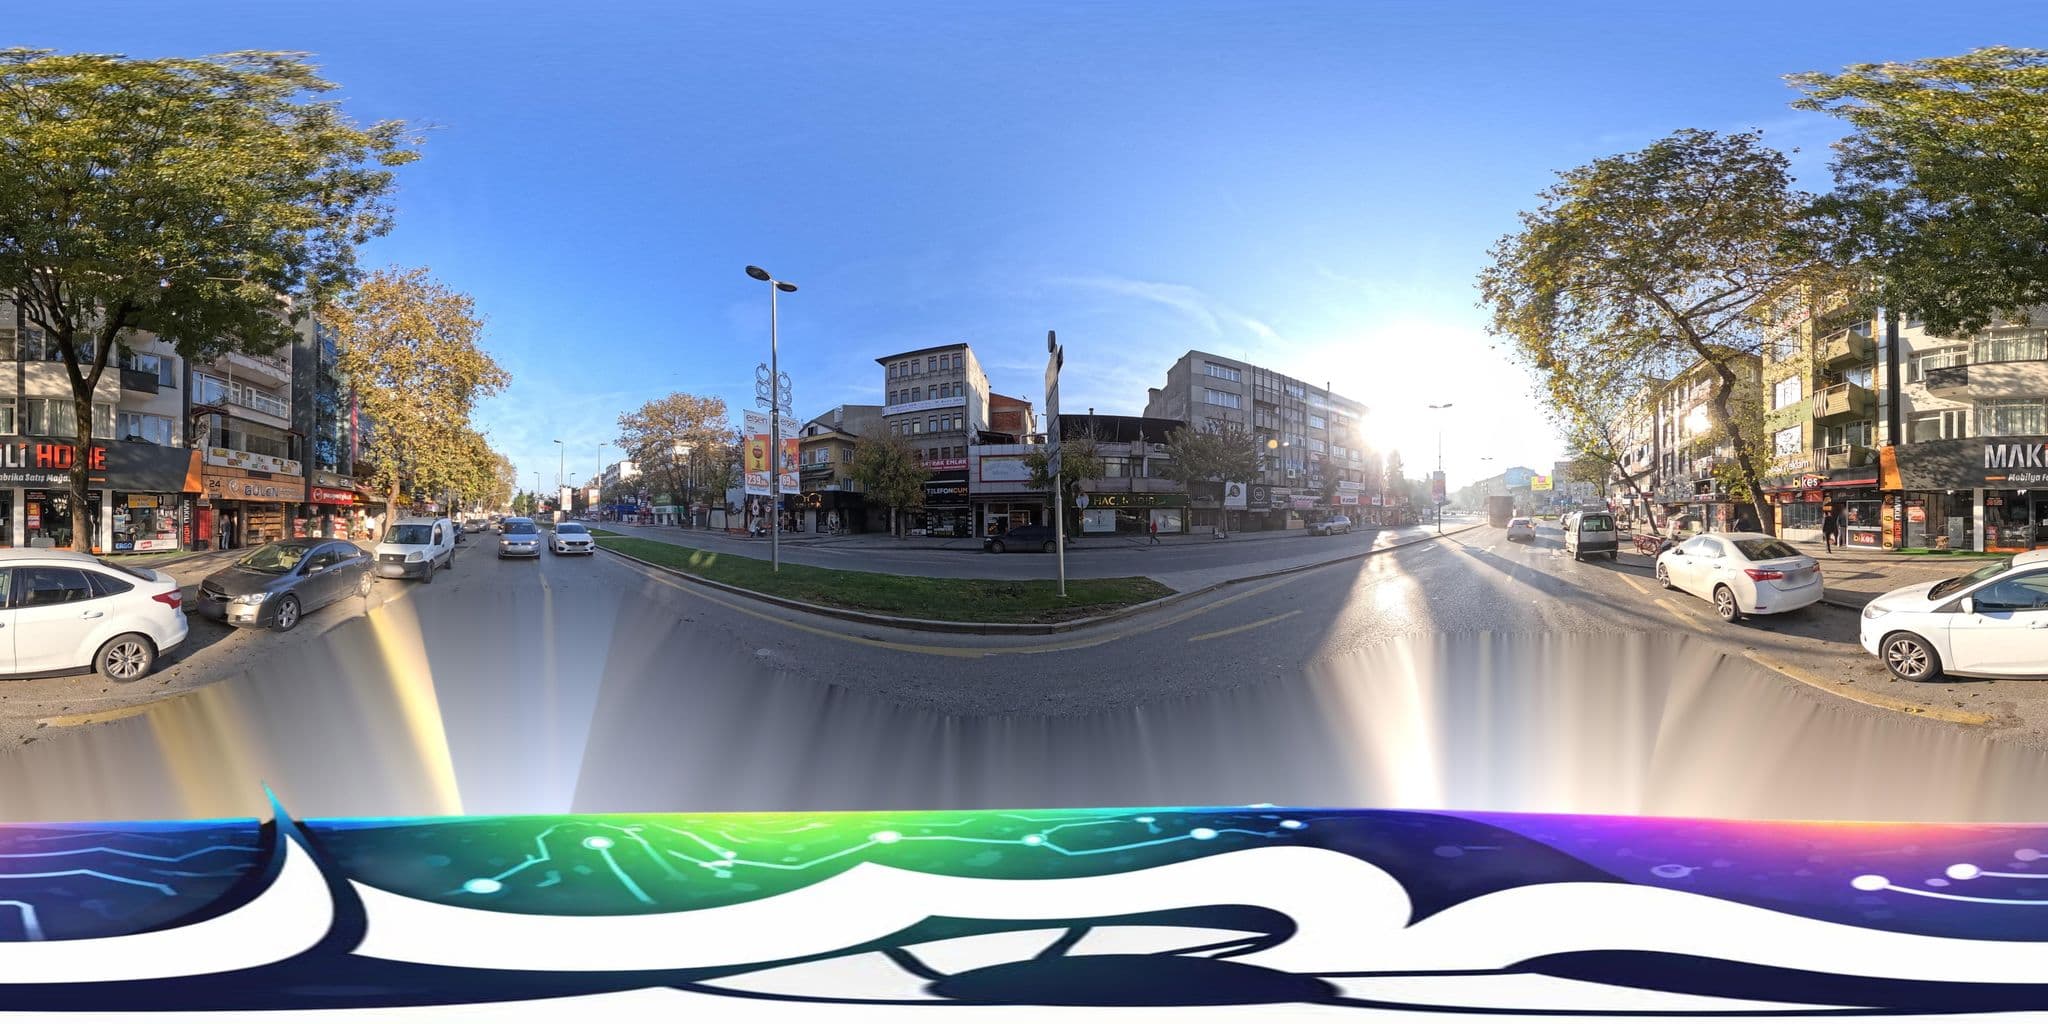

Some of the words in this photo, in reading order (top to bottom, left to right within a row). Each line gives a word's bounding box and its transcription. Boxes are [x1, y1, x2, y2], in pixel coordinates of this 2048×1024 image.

[46, 474, 71, 484] Mağa
[1793, 476, 1818, 488] bikes
[2008, 473, 2040, 483] Mobilya
[209, 480, 221, 488] 24
